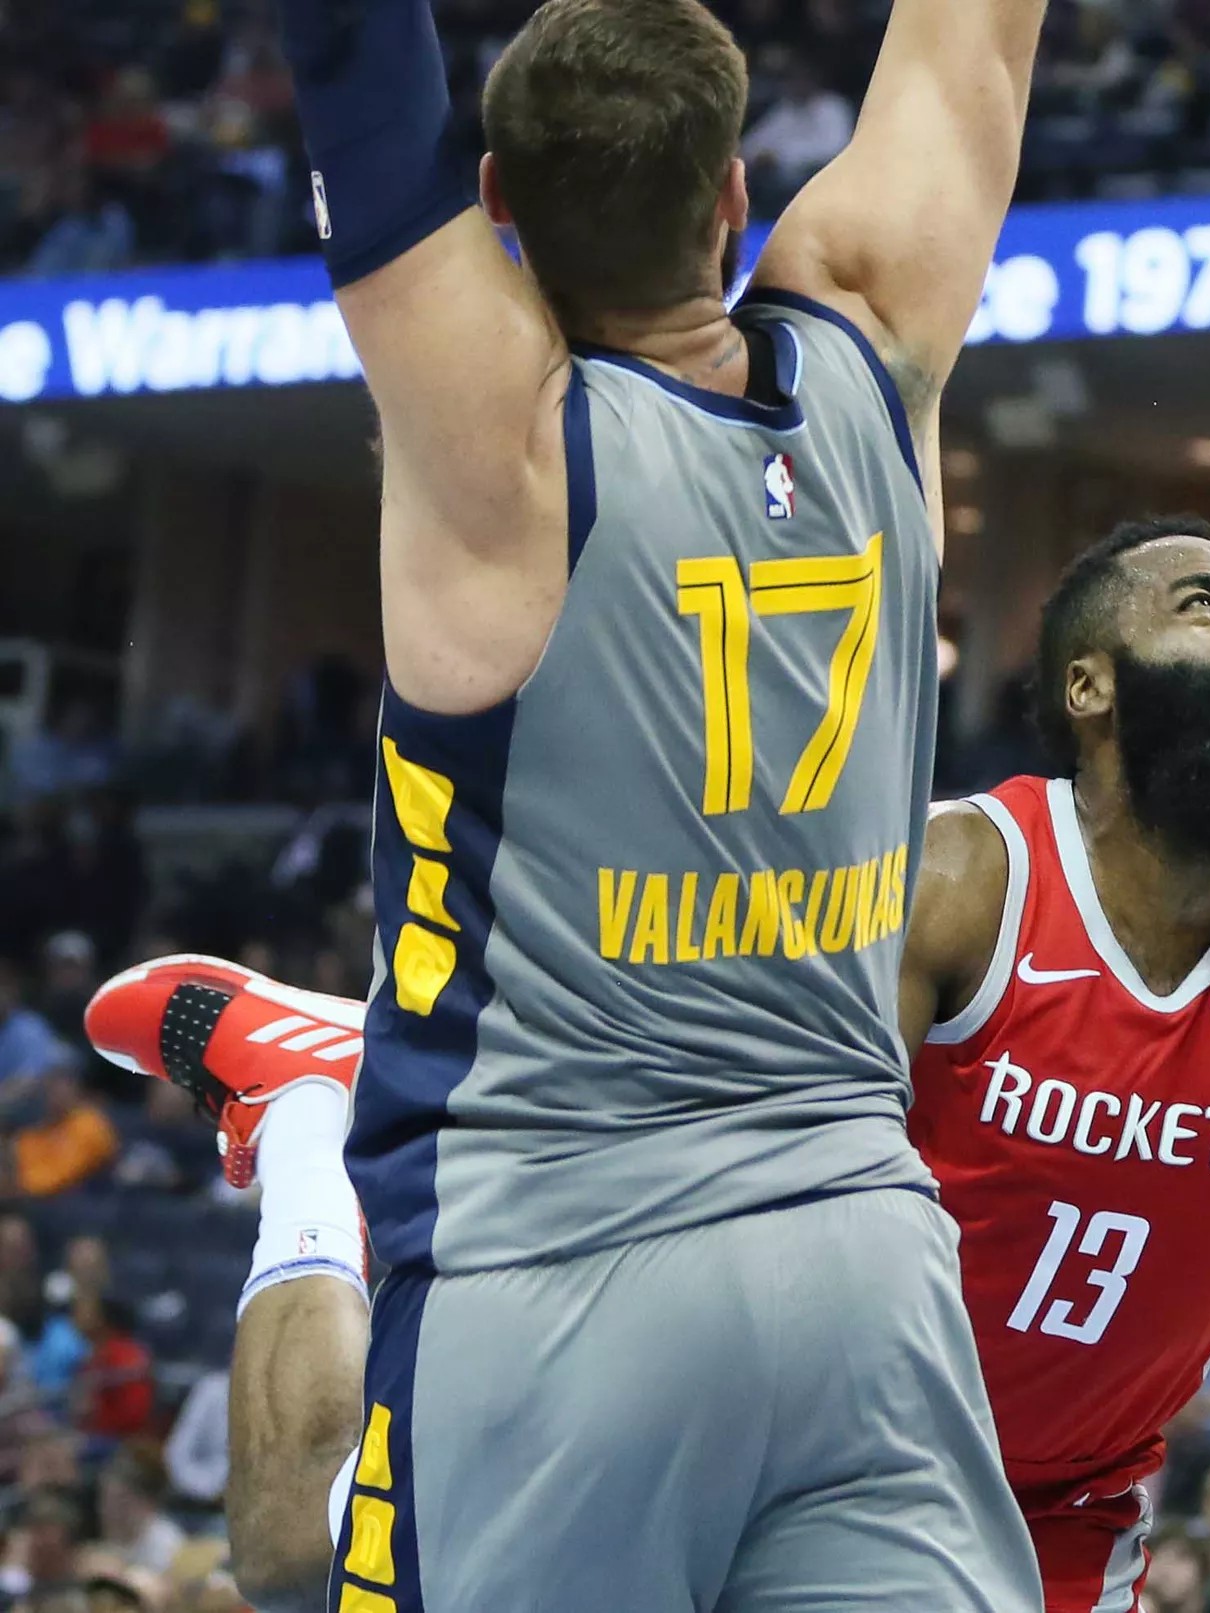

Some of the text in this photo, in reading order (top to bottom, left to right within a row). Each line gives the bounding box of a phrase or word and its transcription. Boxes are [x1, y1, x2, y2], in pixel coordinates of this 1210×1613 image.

[62, 294, 366, 397] Warran
[676, 530, 884, 816] 17
[597, 842, 909, 965] VALANCIUNAS
[1006, 1200, 1151, 1346] 13
